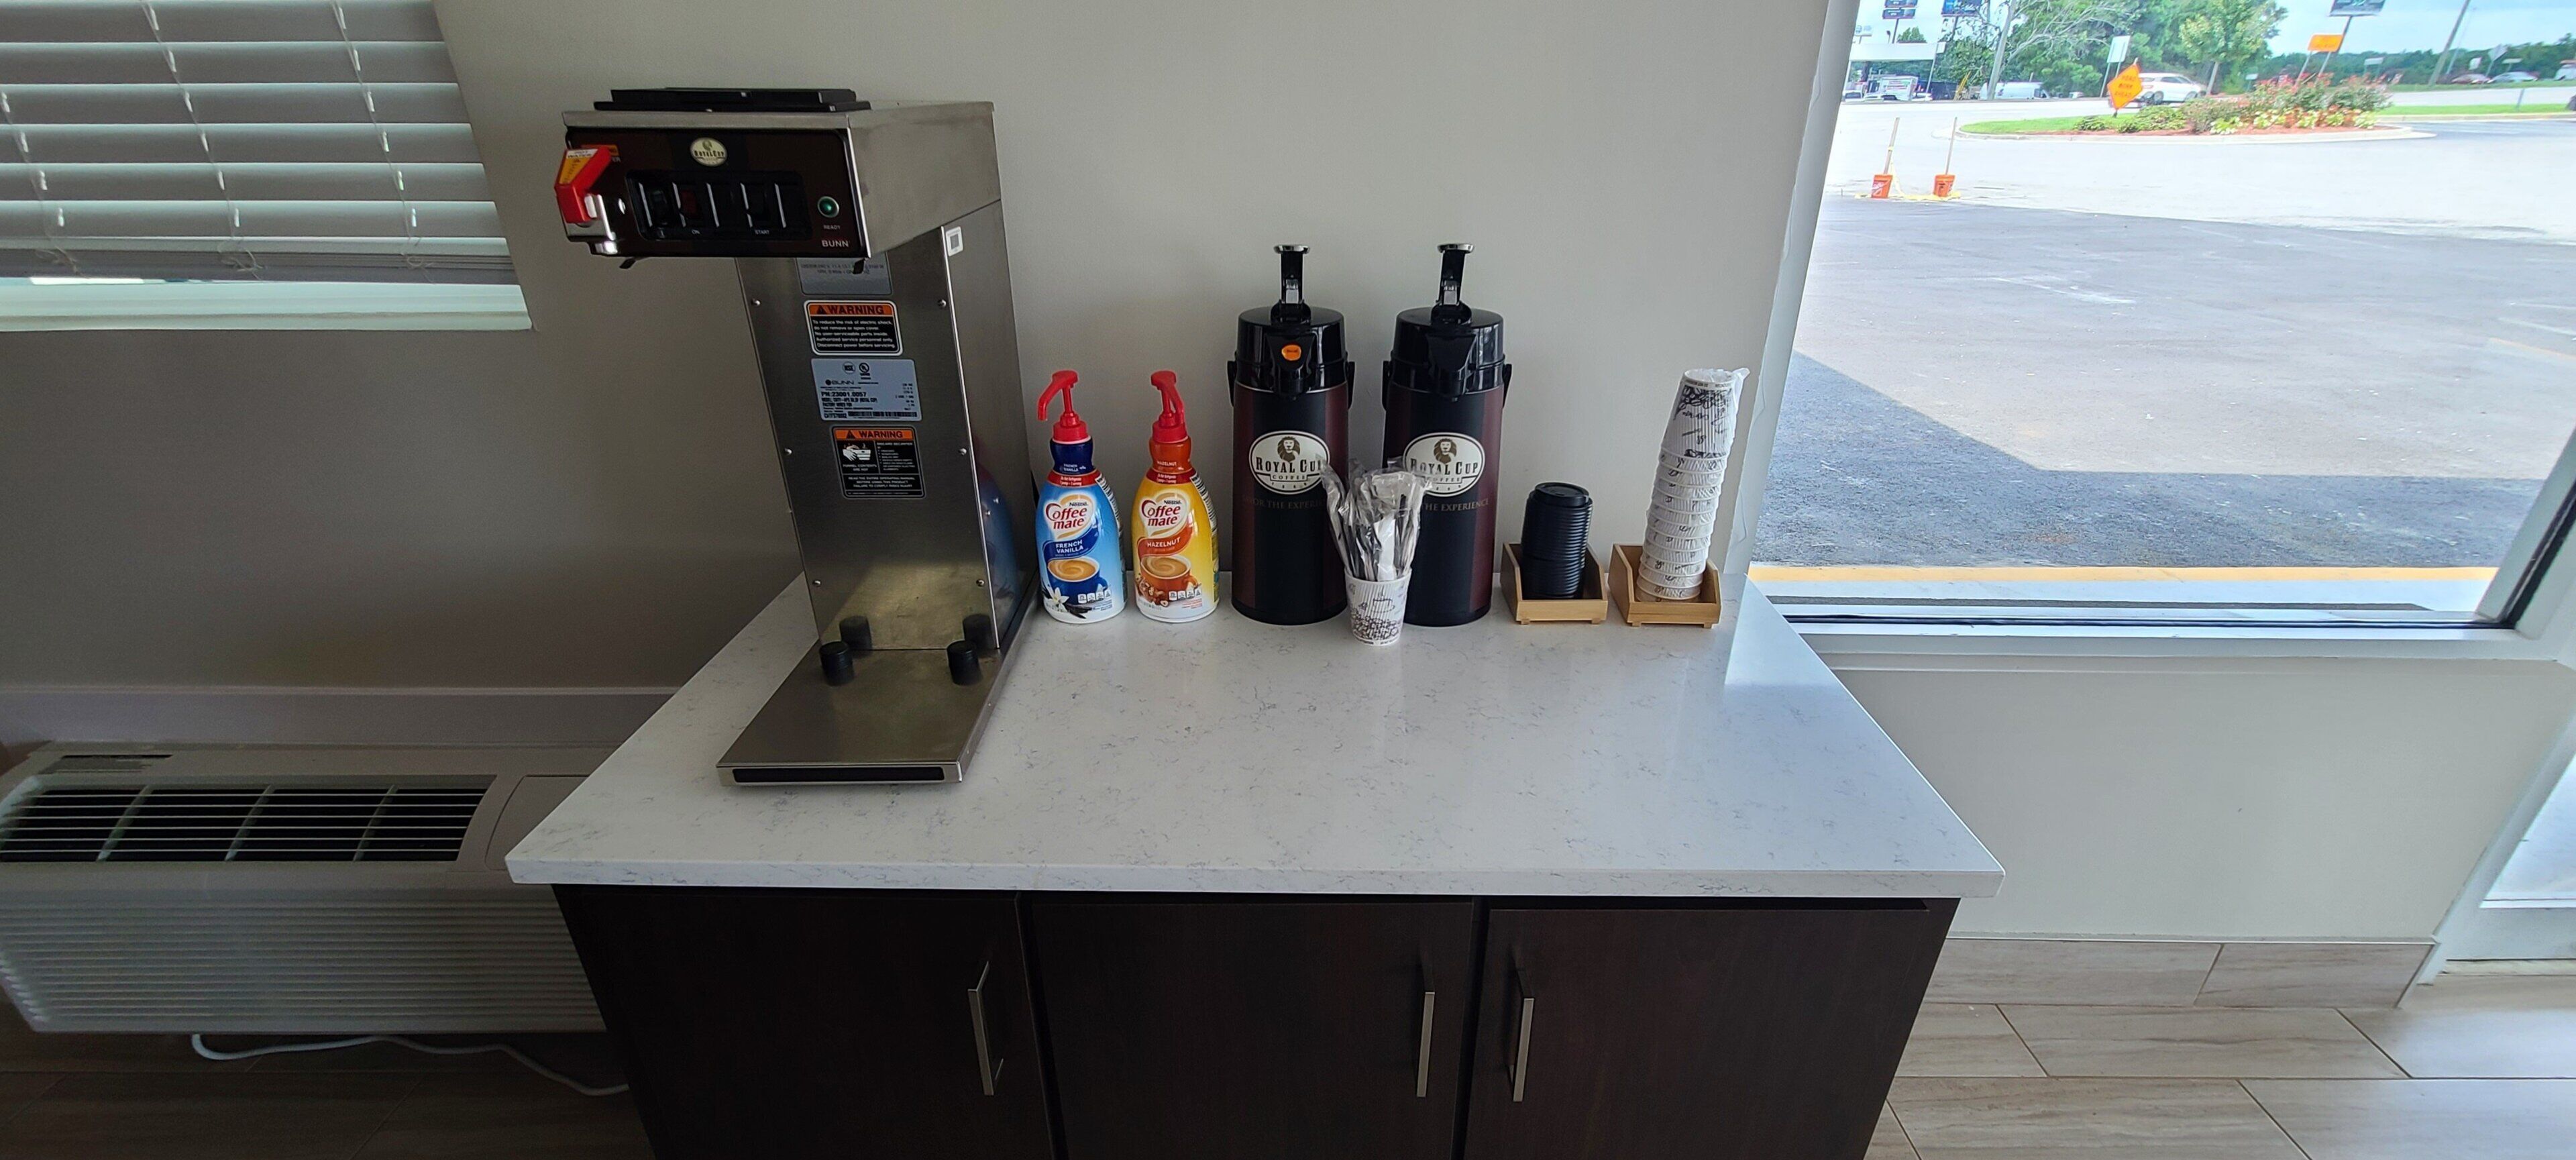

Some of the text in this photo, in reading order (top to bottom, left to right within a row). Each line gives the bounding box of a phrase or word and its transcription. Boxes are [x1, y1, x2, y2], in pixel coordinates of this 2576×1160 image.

[822, 240, 849, 248] BUNN
[828, 305, 885, 315] WARNING
[1256, 457, 1295, 473] ROYAL
[1410, 458, 1479, 475] ROYAL CUP
[1141, 499, 1181, 519] Coffee
[1267, 500, 1284, 509] THE
[1422, 498, 1489, 511] HE EXPERIENCE
[1045, 503, 1087, 521] Coffee
[1053, 518, 1085, 529] mate
[1147, 516, 1178, 527] mate
[1055, 539, 1083, 548] FRENCH
[1146, 537, 1181, 547] HAZELNUT
[1056, 545, 1084, 553] VANILLA
